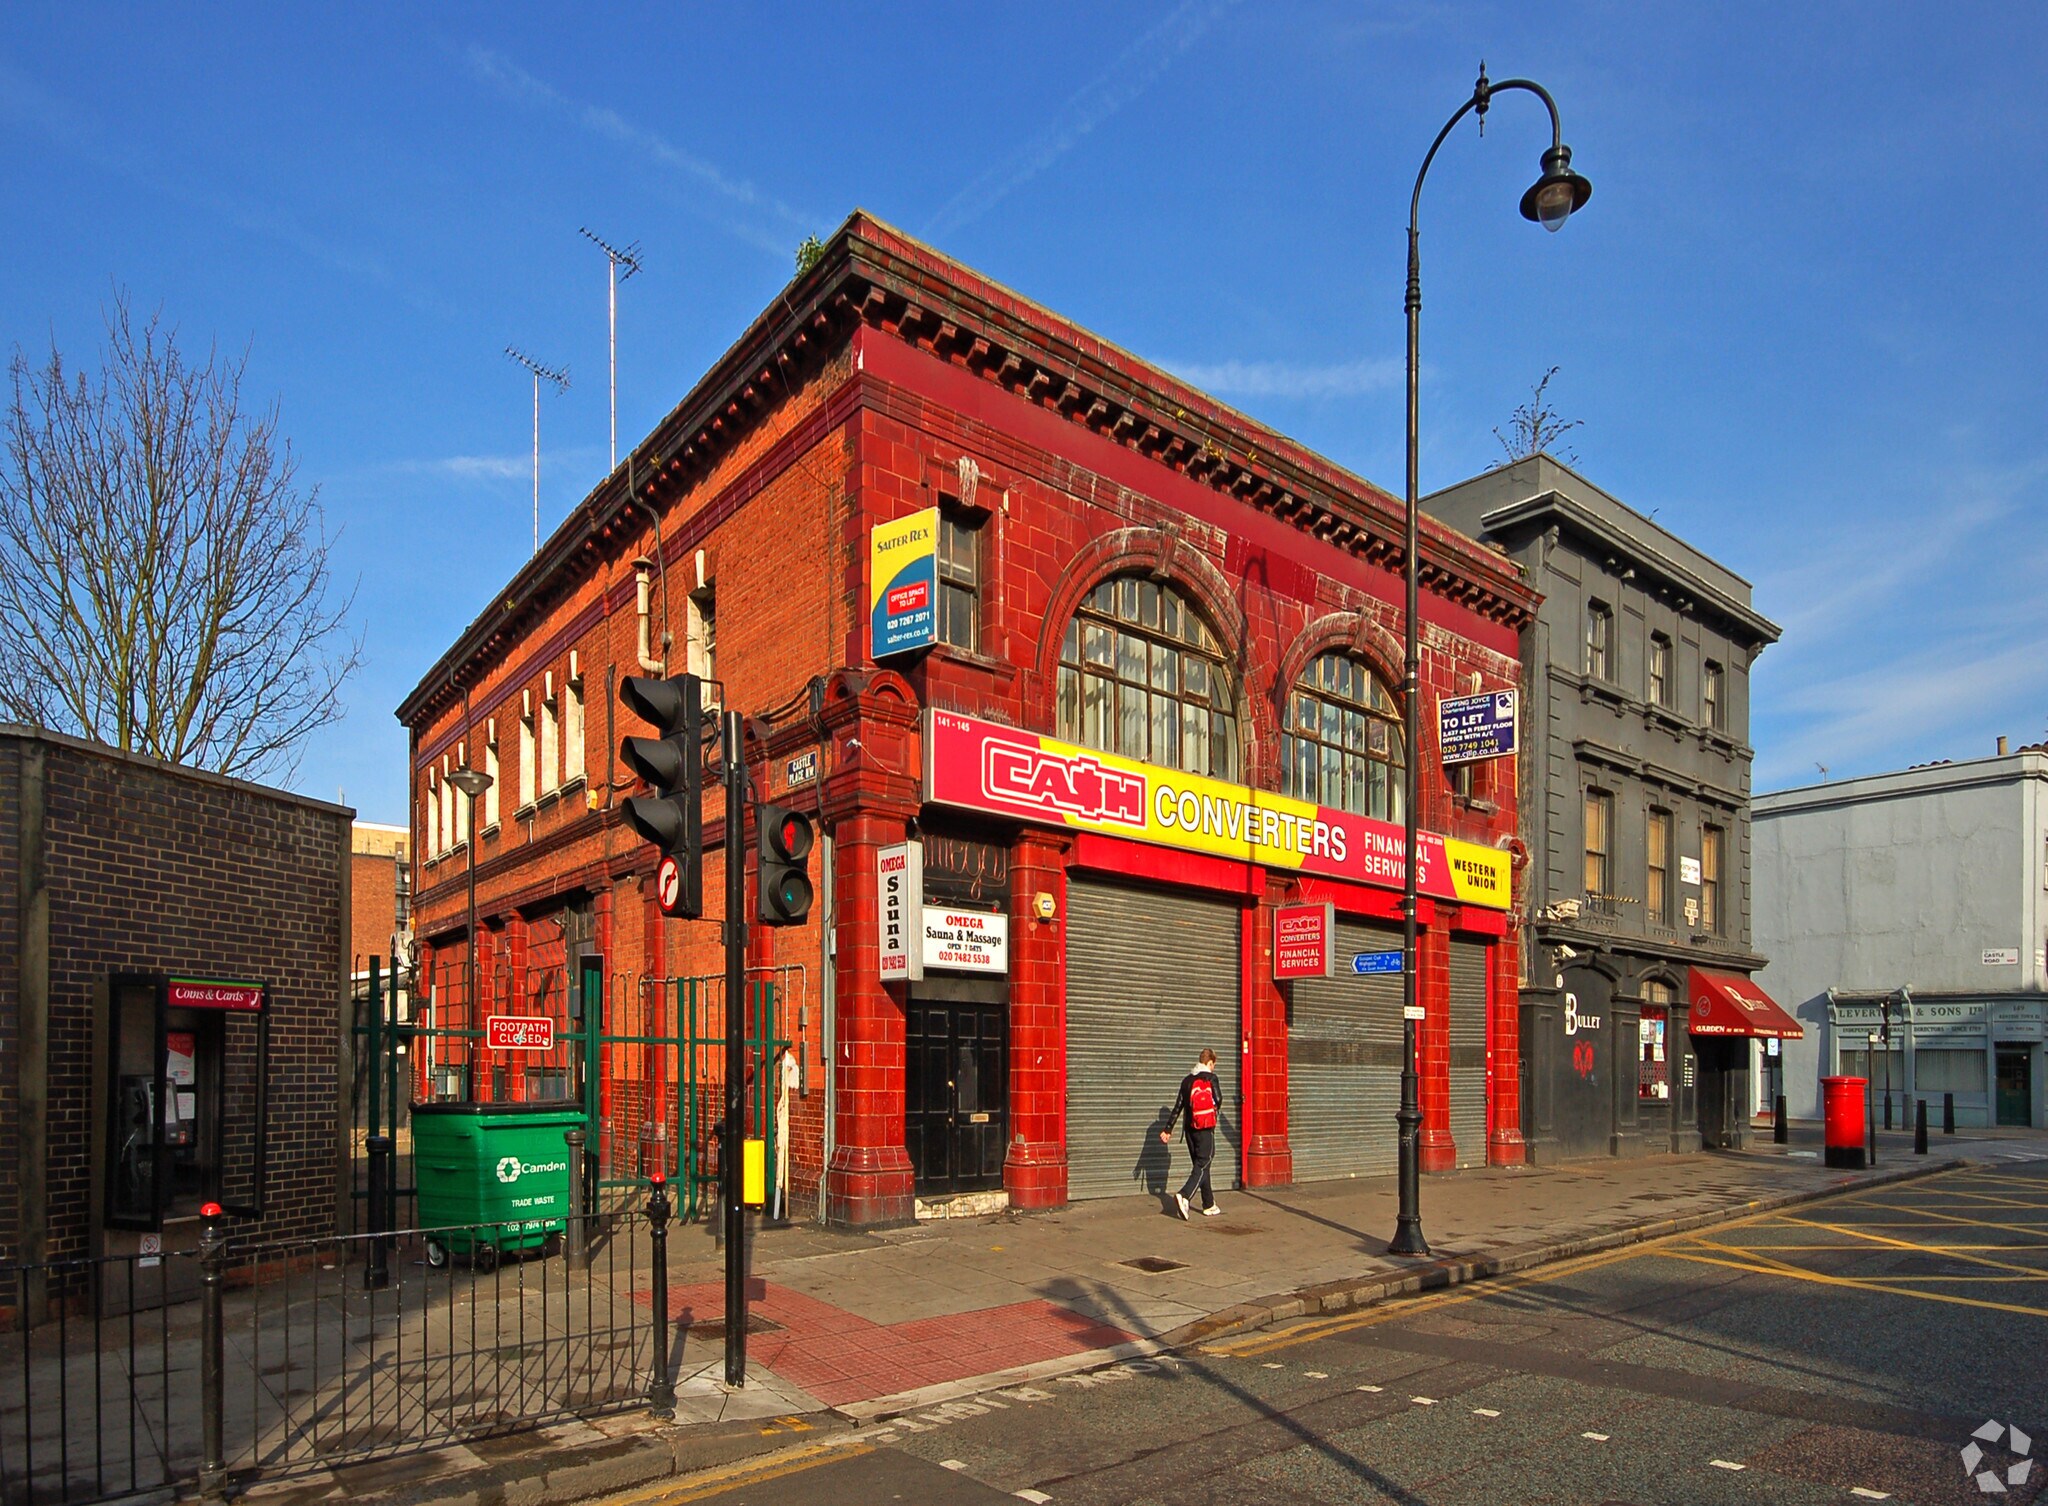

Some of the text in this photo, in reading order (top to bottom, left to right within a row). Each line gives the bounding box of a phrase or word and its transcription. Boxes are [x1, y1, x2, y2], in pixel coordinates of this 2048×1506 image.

[877, 528, 928, 554] SALTER REX
[890, 587, 925, 602] OFFICE SPACE
[899, 597, 916, 608] TO LET
[887, 619, 898, 630] 020
[915, 611, 930, 623] 2071
[887, 626, 930, 644] salter-rex.co.uk
[937, 716, 950, 728] 141
[957, 720, 970, 732] 145
[1442, 718, 1459, 730] TO
[1462, 713, 1485, 727] LET
[1474, 725, 1491, 733] FIRST
[1493, 721, 1513, 730] FLOOR
[1443, 730, 1494, 744] OFFICE WITH A/C
[1443, 739, 1499, 754] 020 7749 1041
[792, 754, 811, 772] CASTLE
[1154, 785, 1347, 863] CONVERTERS
[1364, 831, 1431, 865] FINANAL
[880, 854, 905, 874] OMEGA
[1364, 854, 1427, 884] SERVIS
[1454, 858, 1496, 878] WESTERN
[1467, 875, 1496, 891] UNION
[887, 875, 900, 950] Sauna
[946, 915, 983, 929] OMEGA
[926, 926, 1002, 947] Sauna & Massage
[1280, 933, 1320, 943] CONVERTERS
[969, 944, 982, 952] DAYS
[1280, 948, 1320, 959] FINANCIAL
[939, 951, 990, 964] 020 7482 5538
[1281, 958, 1319, 968] SERVICES
[175, 987, 244, 1001] Coins & Cards
[1565, 993, 1601, 1035] BULLET
[1915, 1007, 1924, 1016] &
[1931, 1006, 1961, 1016] SONS
[493, 1021, 548, 1033] FOOTPATH
[1696, 1025, 1725, 1033] GARDEN
[499, 1033, 542, 1043] CLOSED
[521, 1161, 566, 1174] Camden
[511, 1195, 554, 1207] TRADE WASTE
